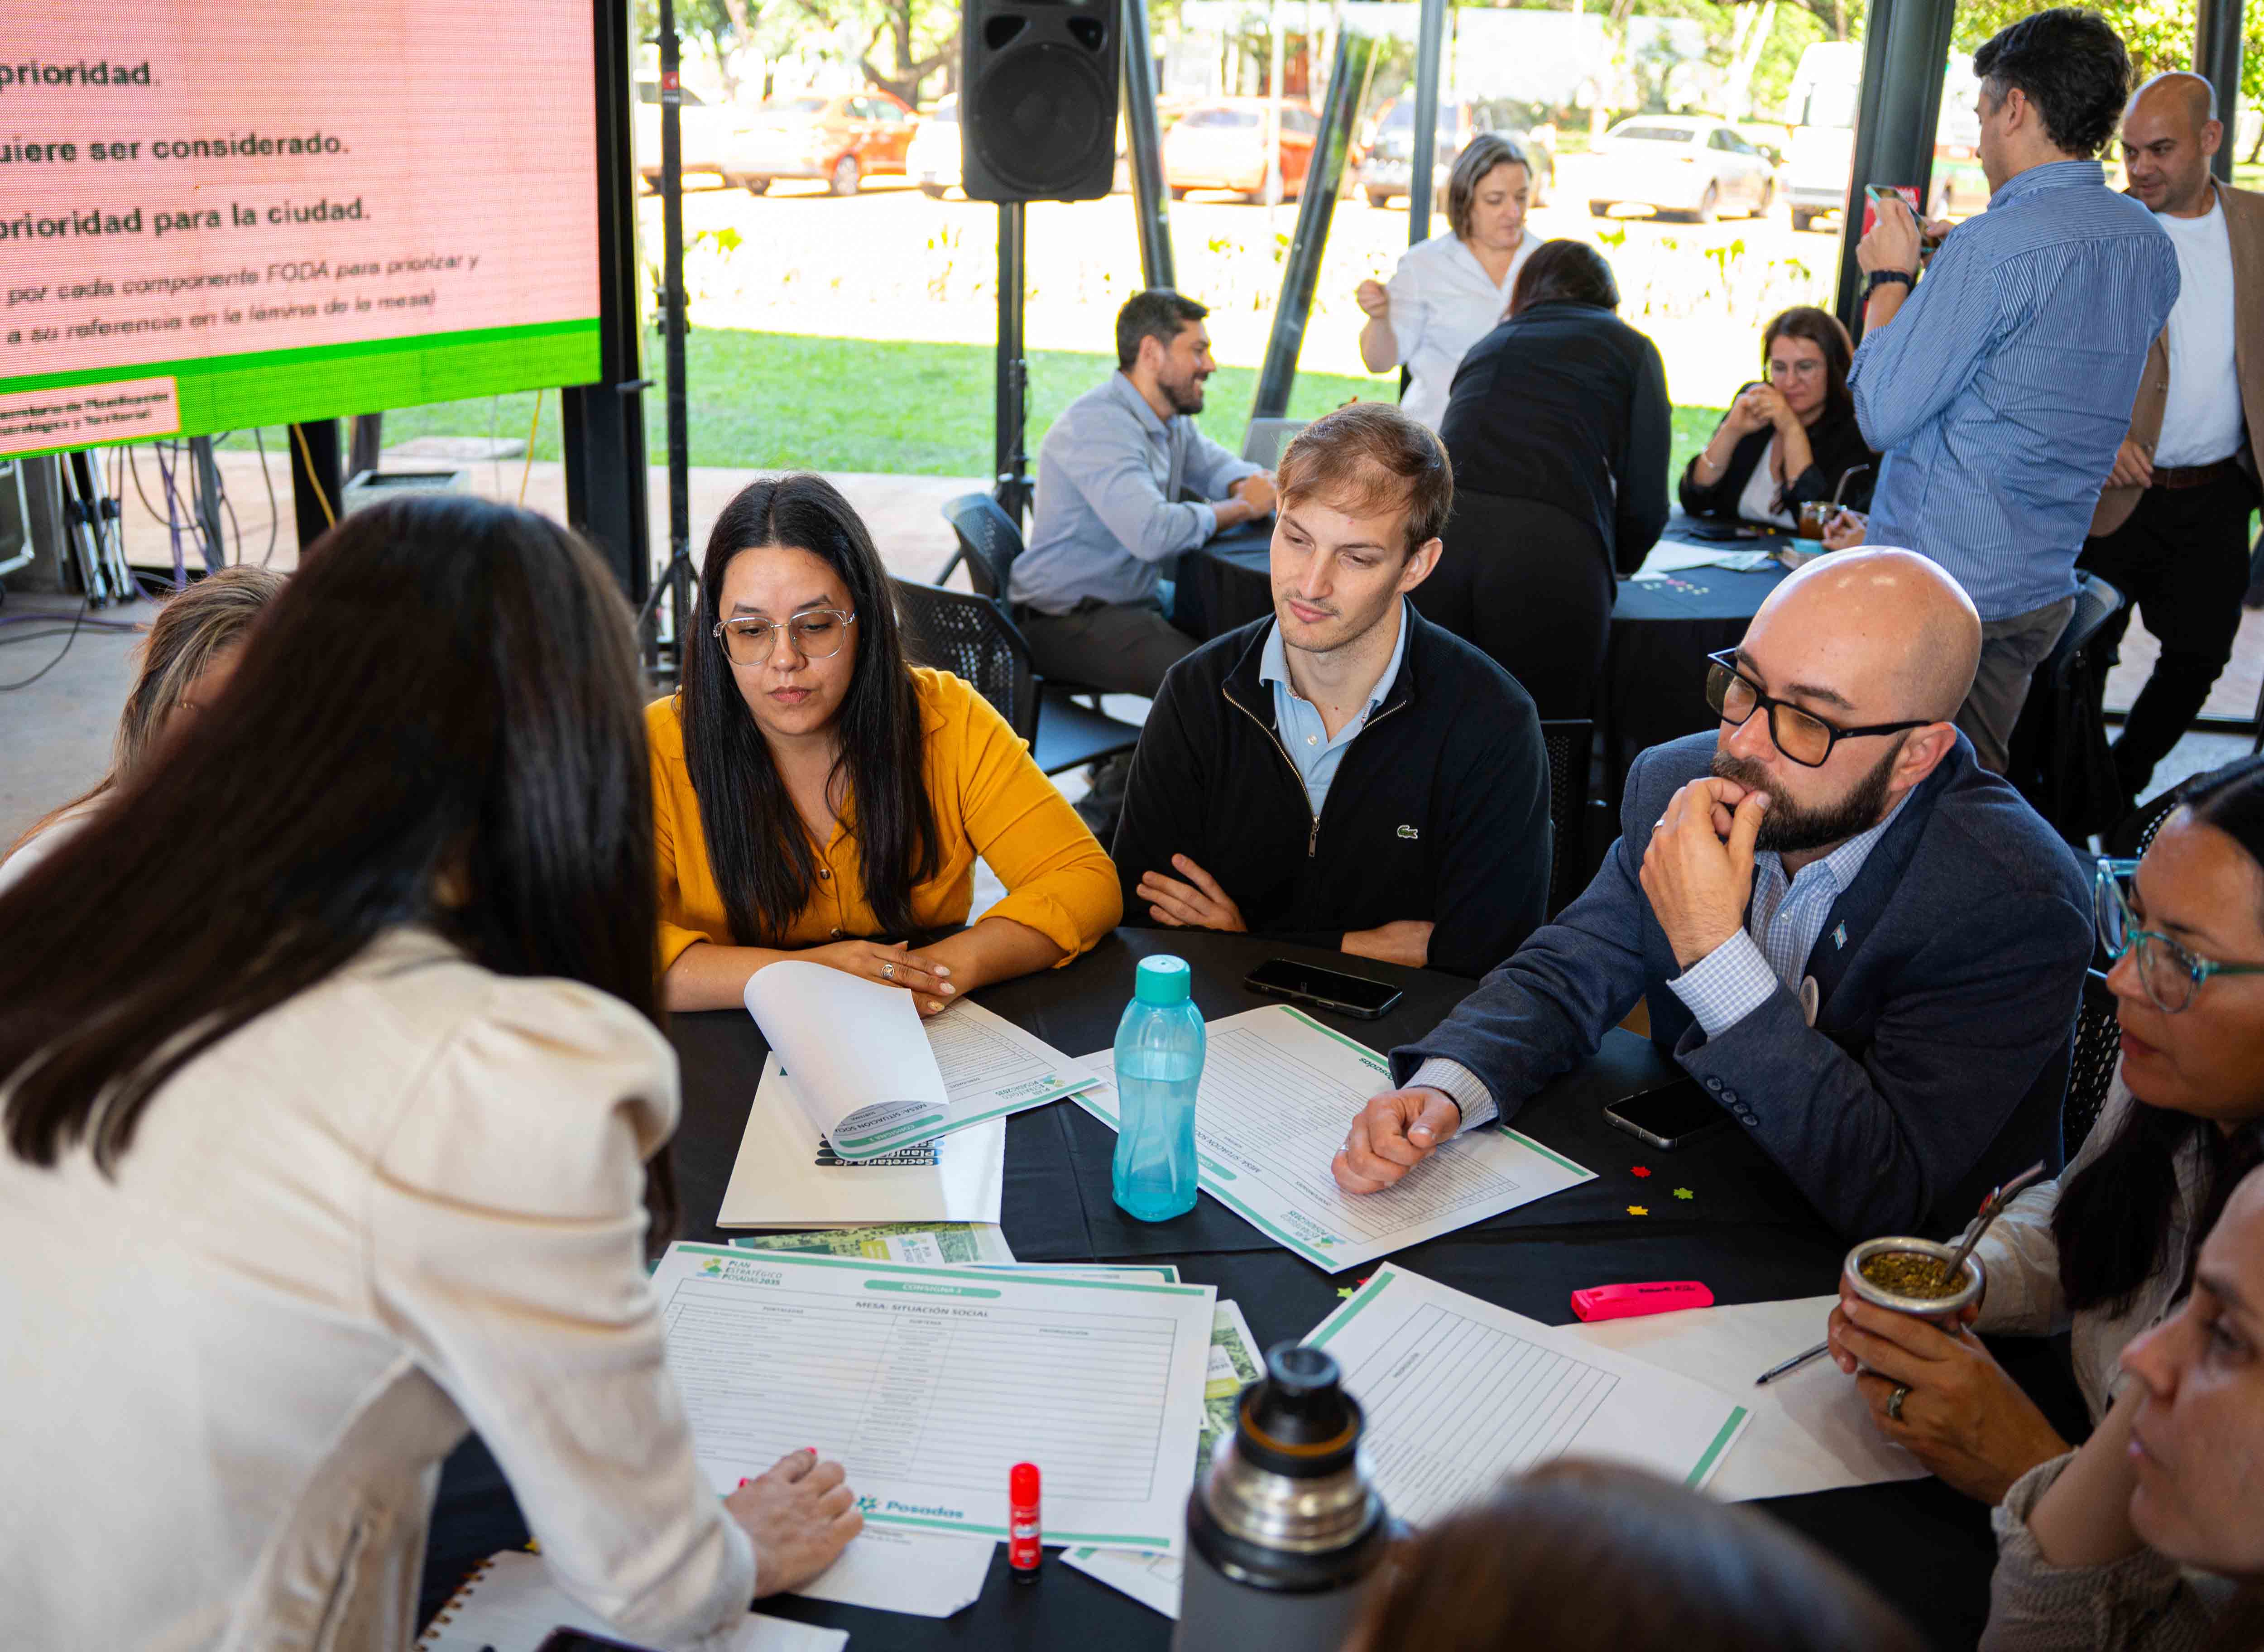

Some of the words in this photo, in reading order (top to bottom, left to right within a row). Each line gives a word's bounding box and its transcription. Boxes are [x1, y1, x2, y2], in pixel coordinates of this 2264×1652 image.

[0, 60, 161, 91] prioridad.
[91, 141, 141, 162] ser
[152, 131, 350, 160] considerado.
[154, 209, 222, 238] para
[232, 202, 257, 226] la
[267, 196, 371, 225] ciudad.
[7, 285, 47, 307] por
[57, 277, 115, 301] cada
[122, 268, 259, 295] componente
[266, 261, 329, 283] FODA
[335, 262, 380, 282] para
[387, 252, 463, 276] priorizar
[469, 255, 480, 270] y
[7, 330, 21, 344] a
[31, 327, 58, 343] su
[66, 316, 182, 340] referencia
[189, 313, 217, 328] en
[223, 307, 242, 324] la
[323, 297, 348, 316] de
[356, 294, 372, 312] la
[858, 1113, 901, 1129] SITUACIÓN
[725, 1267, 783, 1279] ESTRATÉGICO
[729, 1260, 750, 1268] PLAN
[855, 1301, 888, 1311] MESA:
[892, 1303, 949, 1316] SITUACIÓN
[953, 1309, 989, 1318] SOCIAL
[885, 1500, 964, 1519] Posadas
